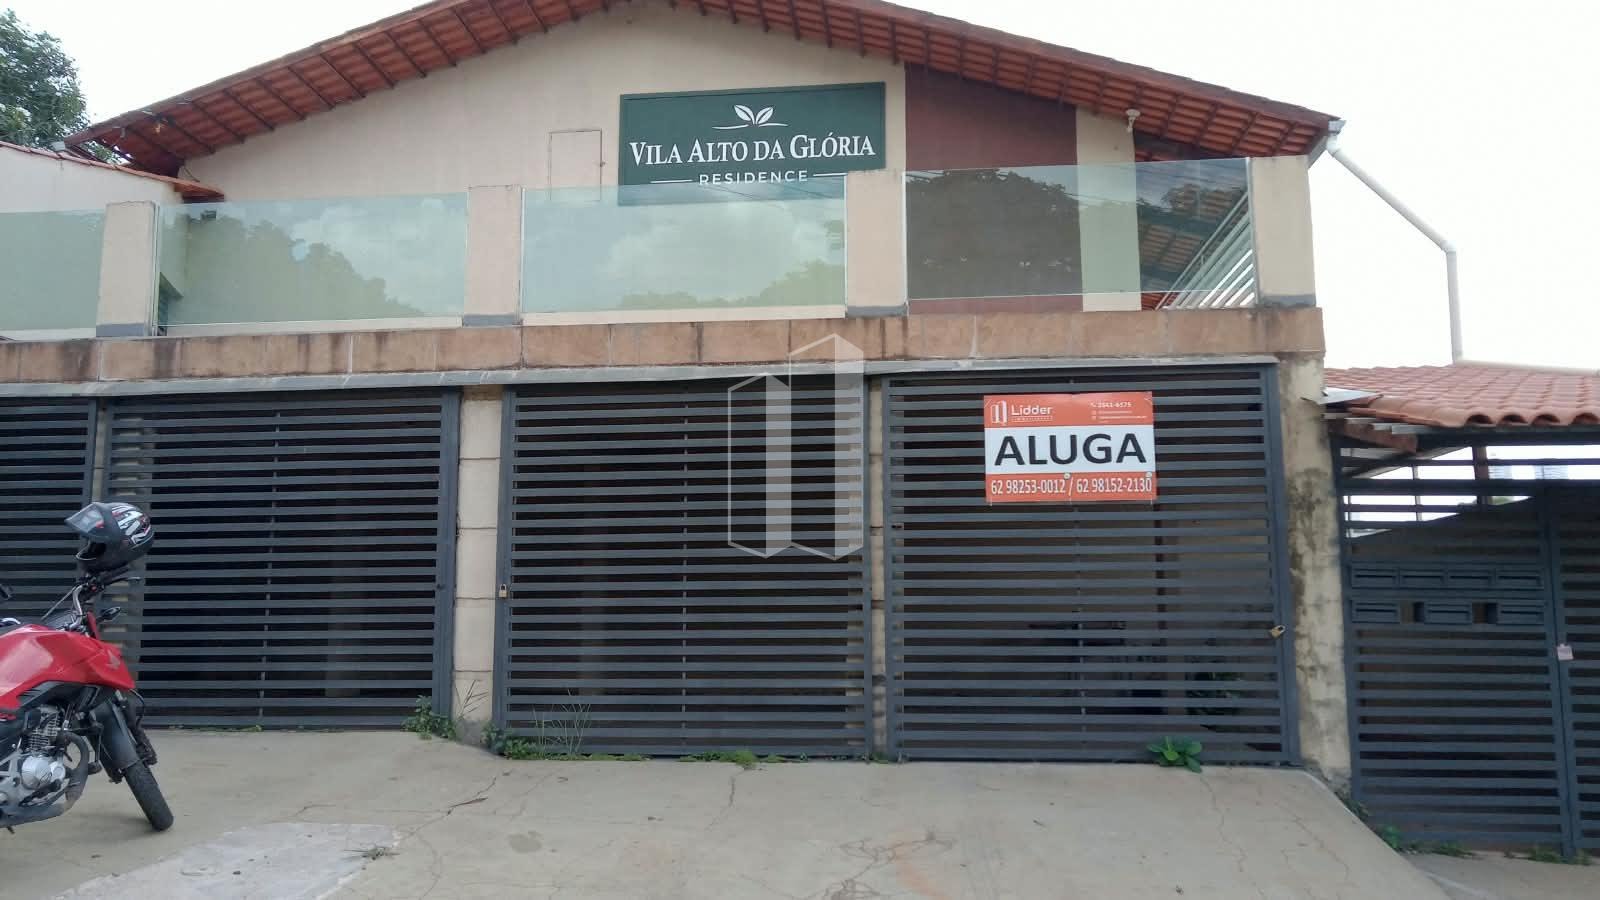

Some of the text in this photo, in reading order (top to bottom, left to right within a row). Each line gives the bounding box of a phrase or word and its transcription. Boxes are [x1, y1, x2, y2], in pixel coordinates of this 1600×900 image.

[629, 131, 875, 166] VILA ALTO DA GLÓRIA
[699, 170, 808, 186] RESIDENCE
[1011, 405, 1052, 416] Lidder
[995, 433, 1147, 466] ALUGA
[991, 479, 1003, 494] 62
[1006, 480, 1066, 494] 98253-0012
[1076, 480, 1088, 493] 62
[1091, 478, 1152, 493] 98152-2130
